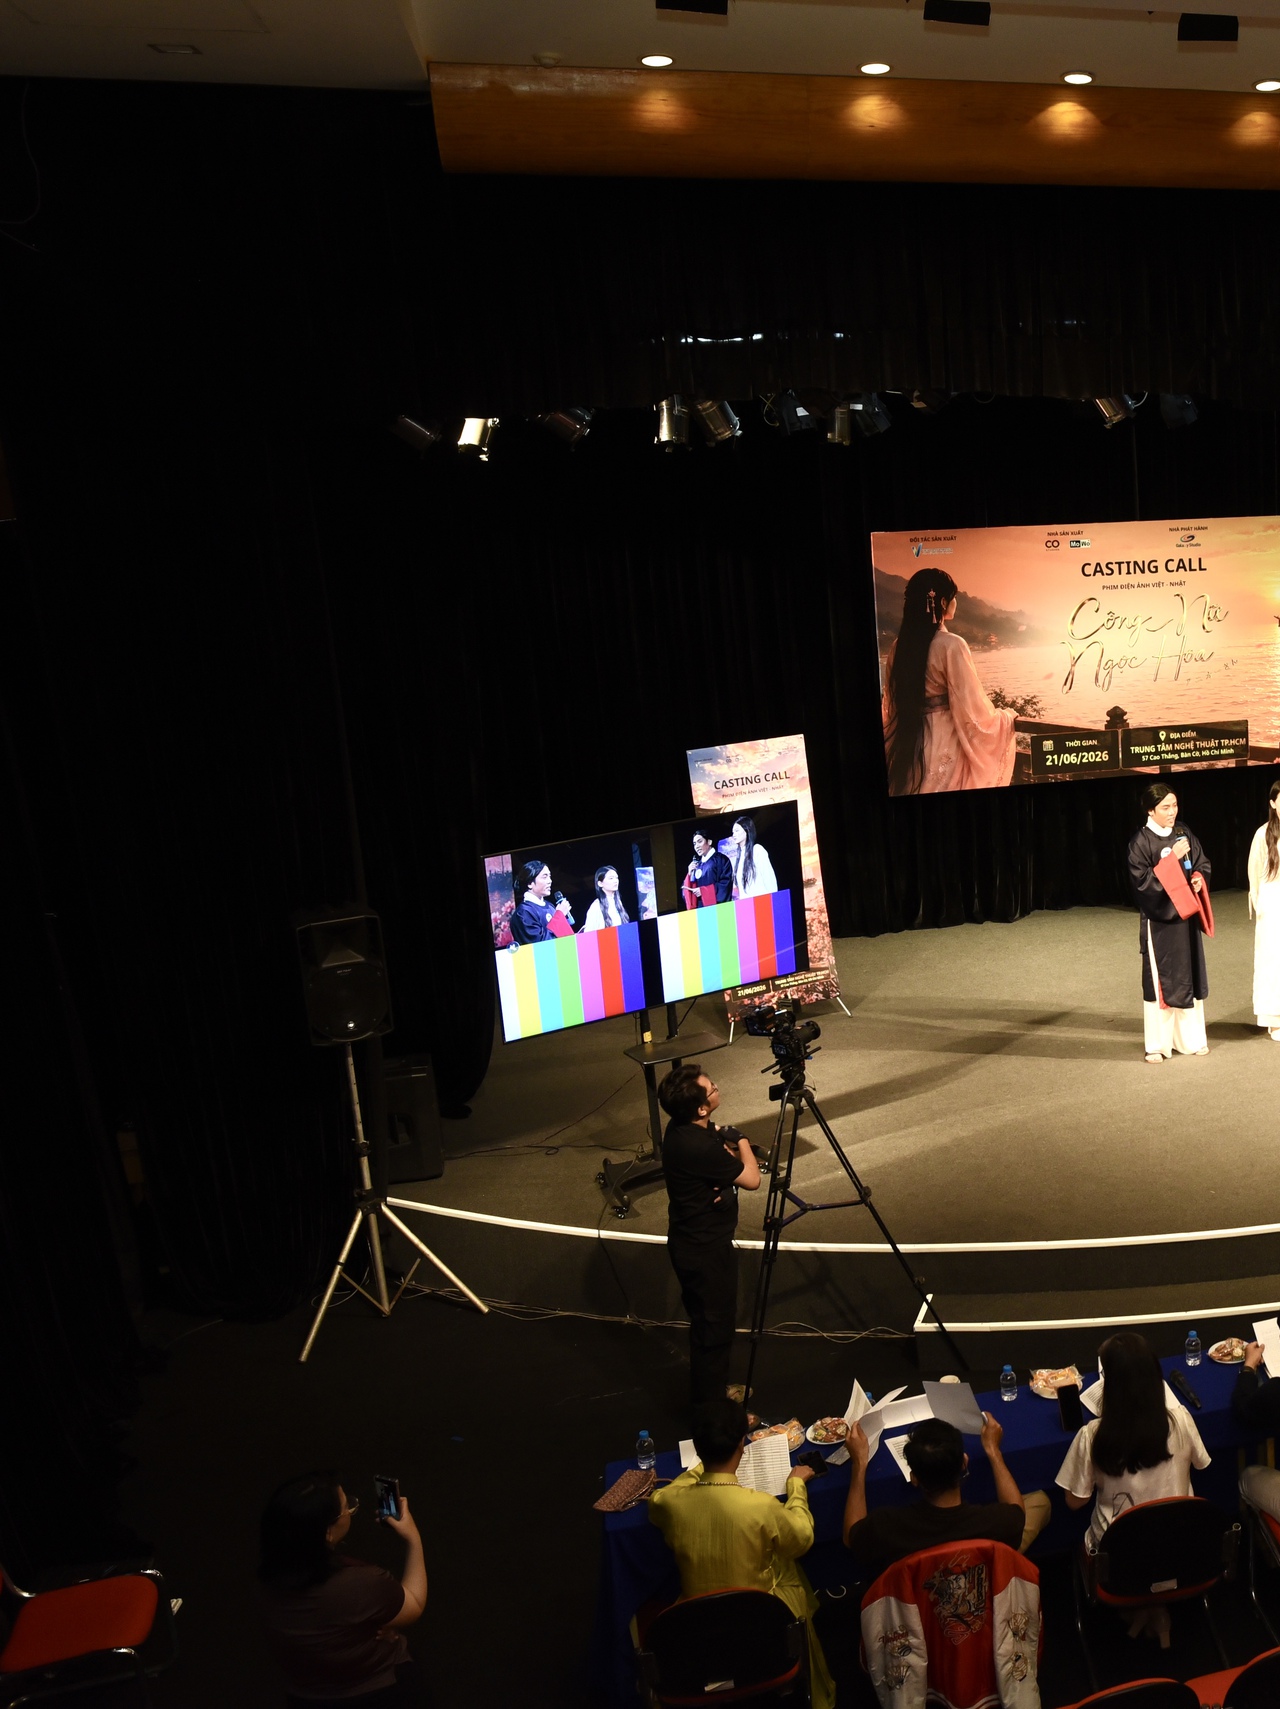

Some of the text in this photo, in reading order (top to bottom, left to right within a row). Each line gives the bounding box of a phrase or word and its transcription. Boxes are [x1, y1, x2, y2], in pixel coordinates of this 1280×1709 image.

[1081, 557, 1207, 577] CASTING CALL
[1120, 583, 1136, 591] ĐIỆN
[1151, 580, 1165, 589] VIỆT
[1169, 580, 1187, 588] NHẬT
[1065, 739, 1098, 748] THỜI GIAN
[1130, 737, 1247, 754] TRUNG TÂM NGHỆ THUẬT TP.HCM
[1045, 750, 1109, 767] 21/06/2026
[713, 770, 791, 790] CASTING CALL
